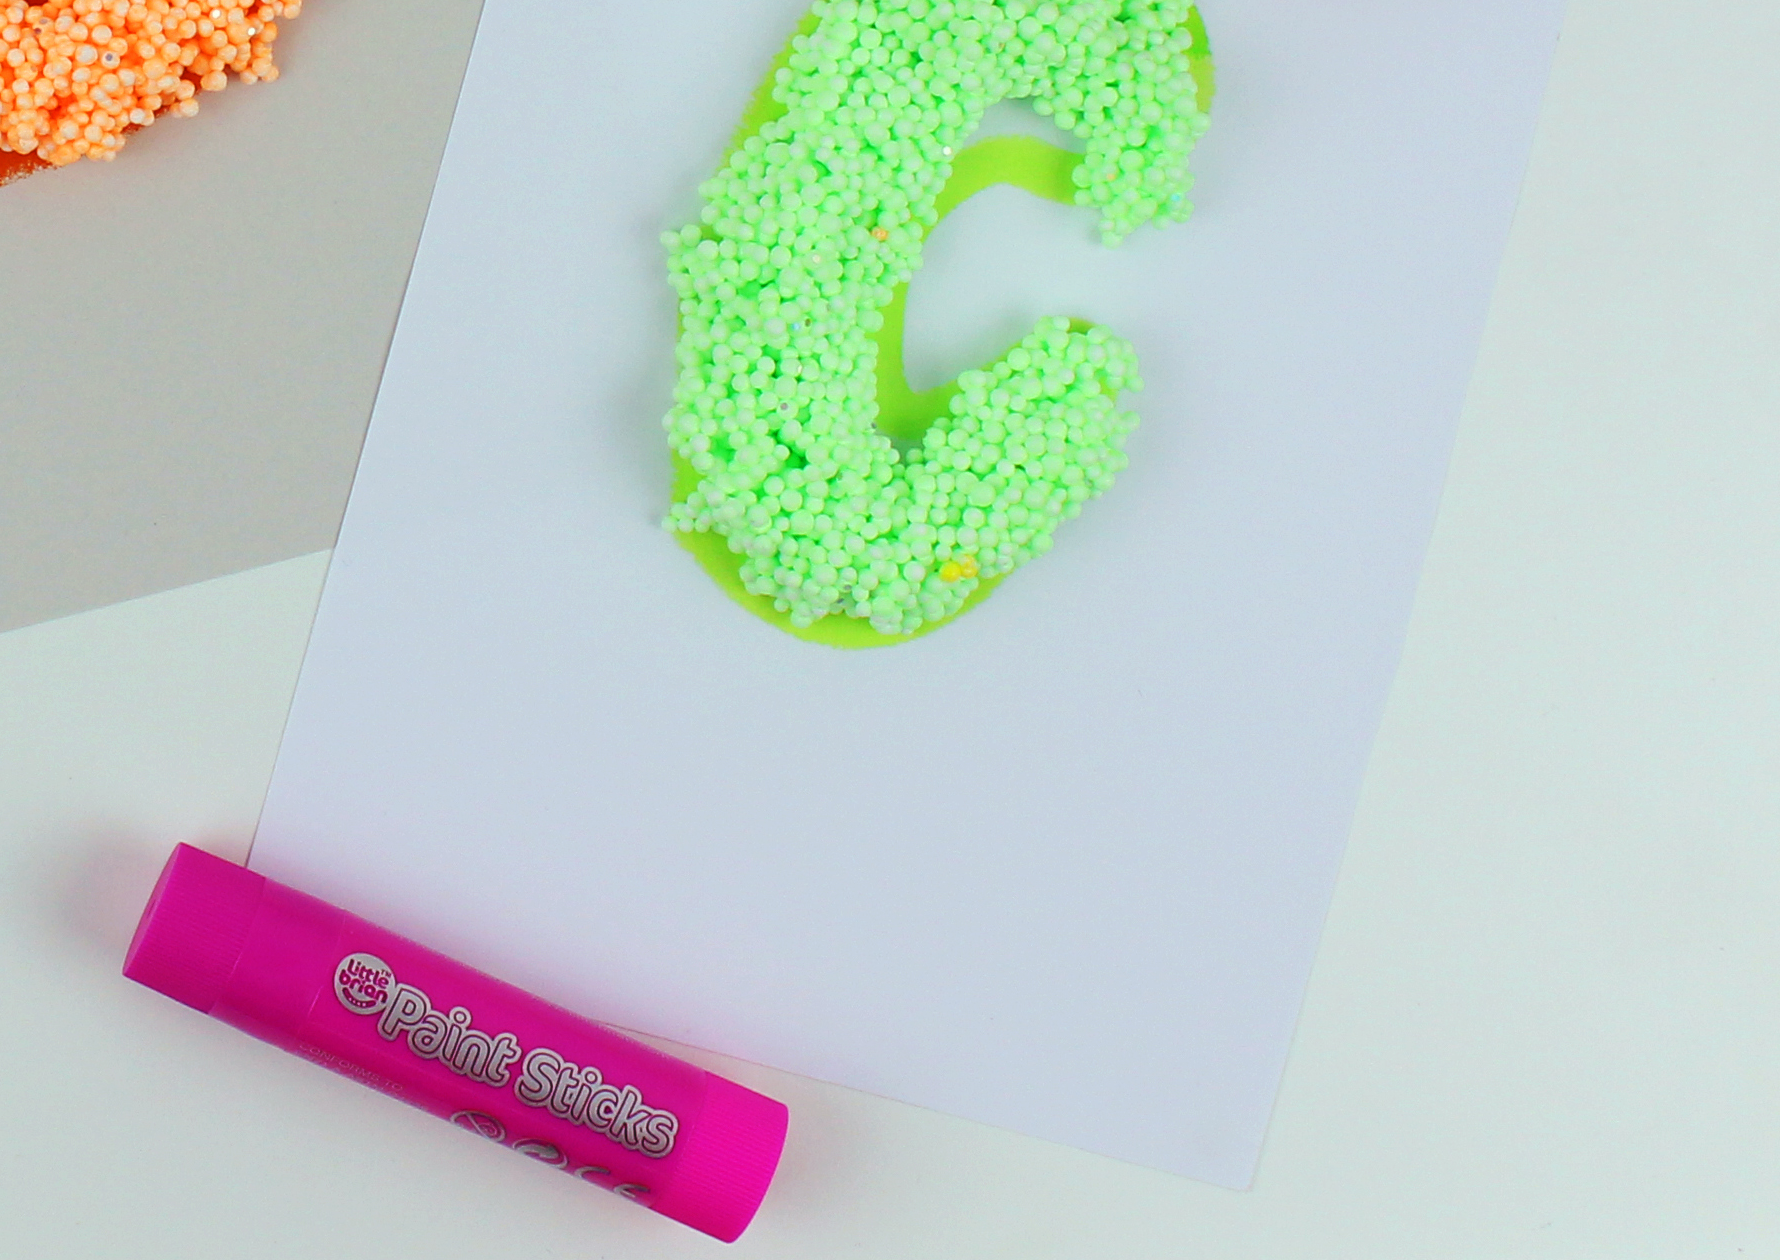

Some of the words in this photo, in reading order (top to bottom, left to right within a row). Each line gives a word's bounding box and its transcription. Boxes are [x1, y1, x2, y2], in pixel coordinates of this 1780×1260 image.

[337, 969, 390, 1003] brian
[345, 958, 391, 990] Little
[378, 982, 521, 1086] Paint
[515, 1048, 678, 1157] Sticks
